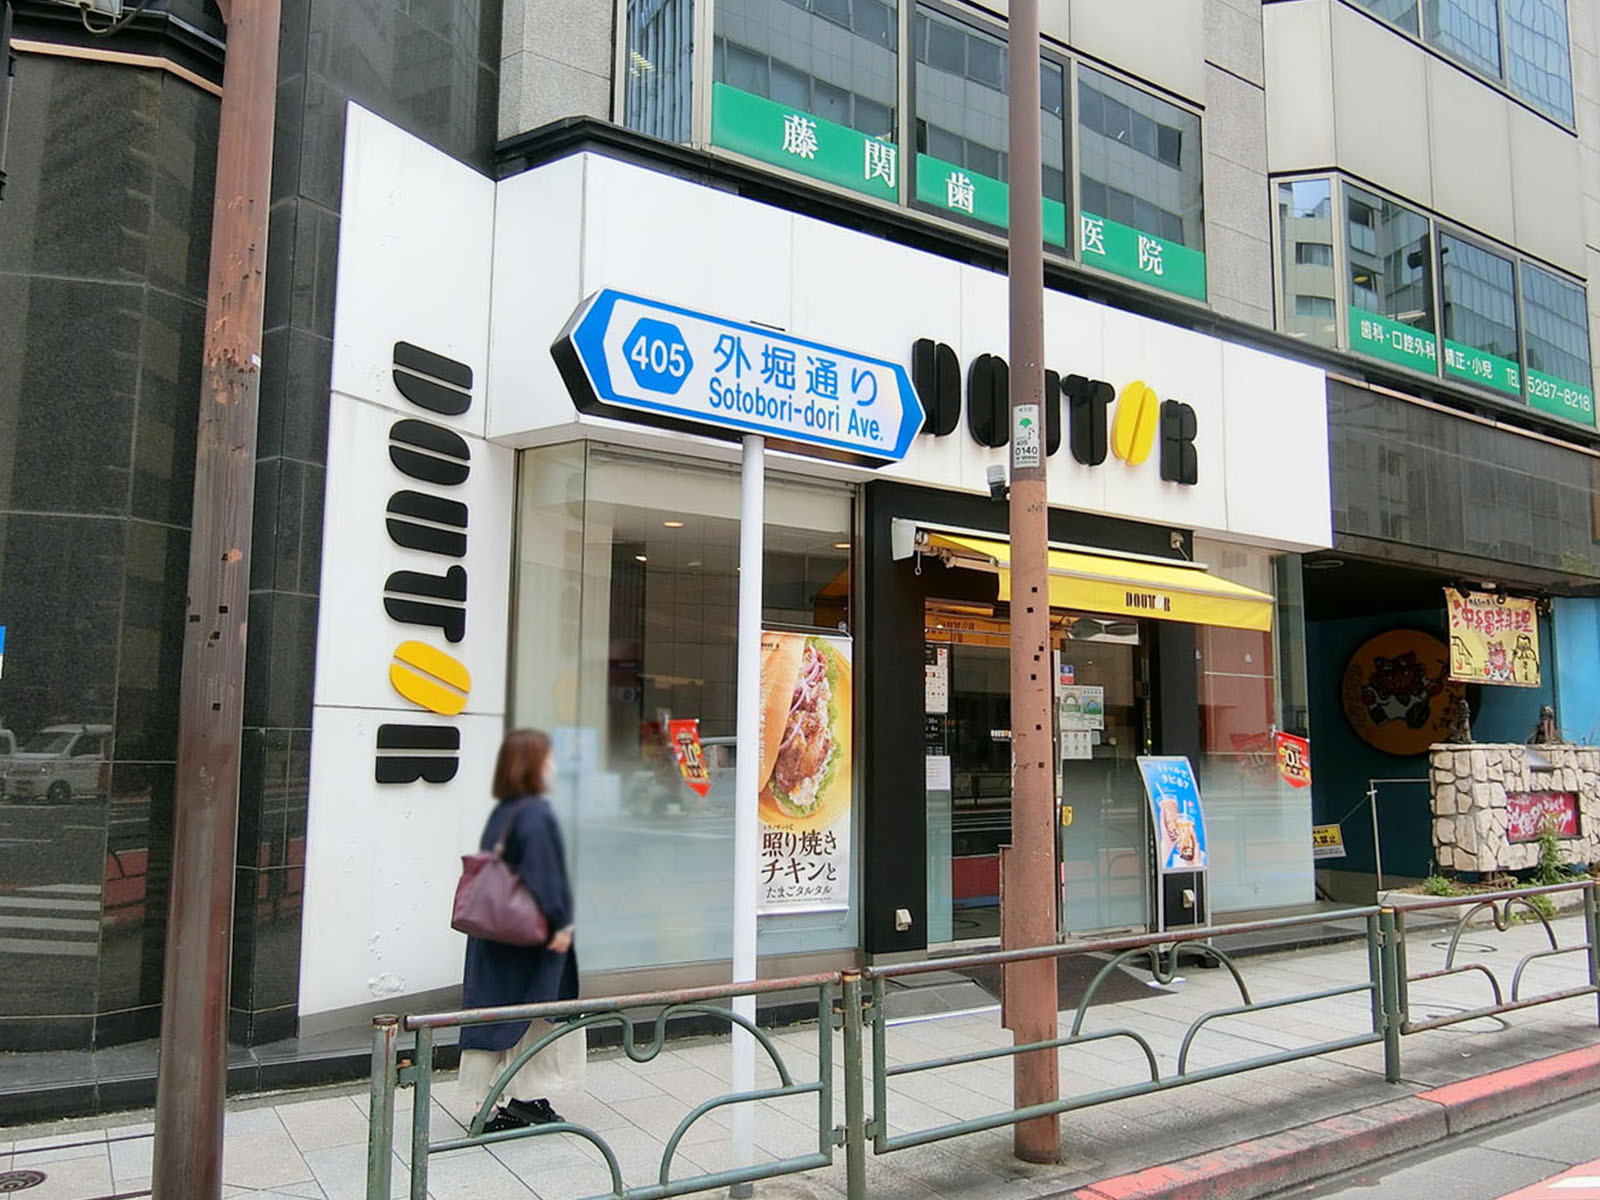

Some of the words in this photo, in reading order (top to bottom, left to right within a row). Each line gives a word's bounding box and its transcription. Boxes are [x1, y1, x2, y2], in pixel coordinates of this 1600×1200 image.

[631, 336, 686, 378] 405
[713, 333, 878, 408] 外堀通り
[708, 376, 840, 433] Sotobori-dori
[847, 407, 884, 442] Ave.
[1506, 367, 1521, 389] TEL
[1527, 375, 1591, 413] 5297-8218
[1015, 446, 1038, 456] 0140
[375, 340, 473, 784] DOUTOR
[762, 829, 837, 857] 照り焼き
[761, 857, 837, 884] チキンと
[766, 885, 833, 899] たまごタルタル
